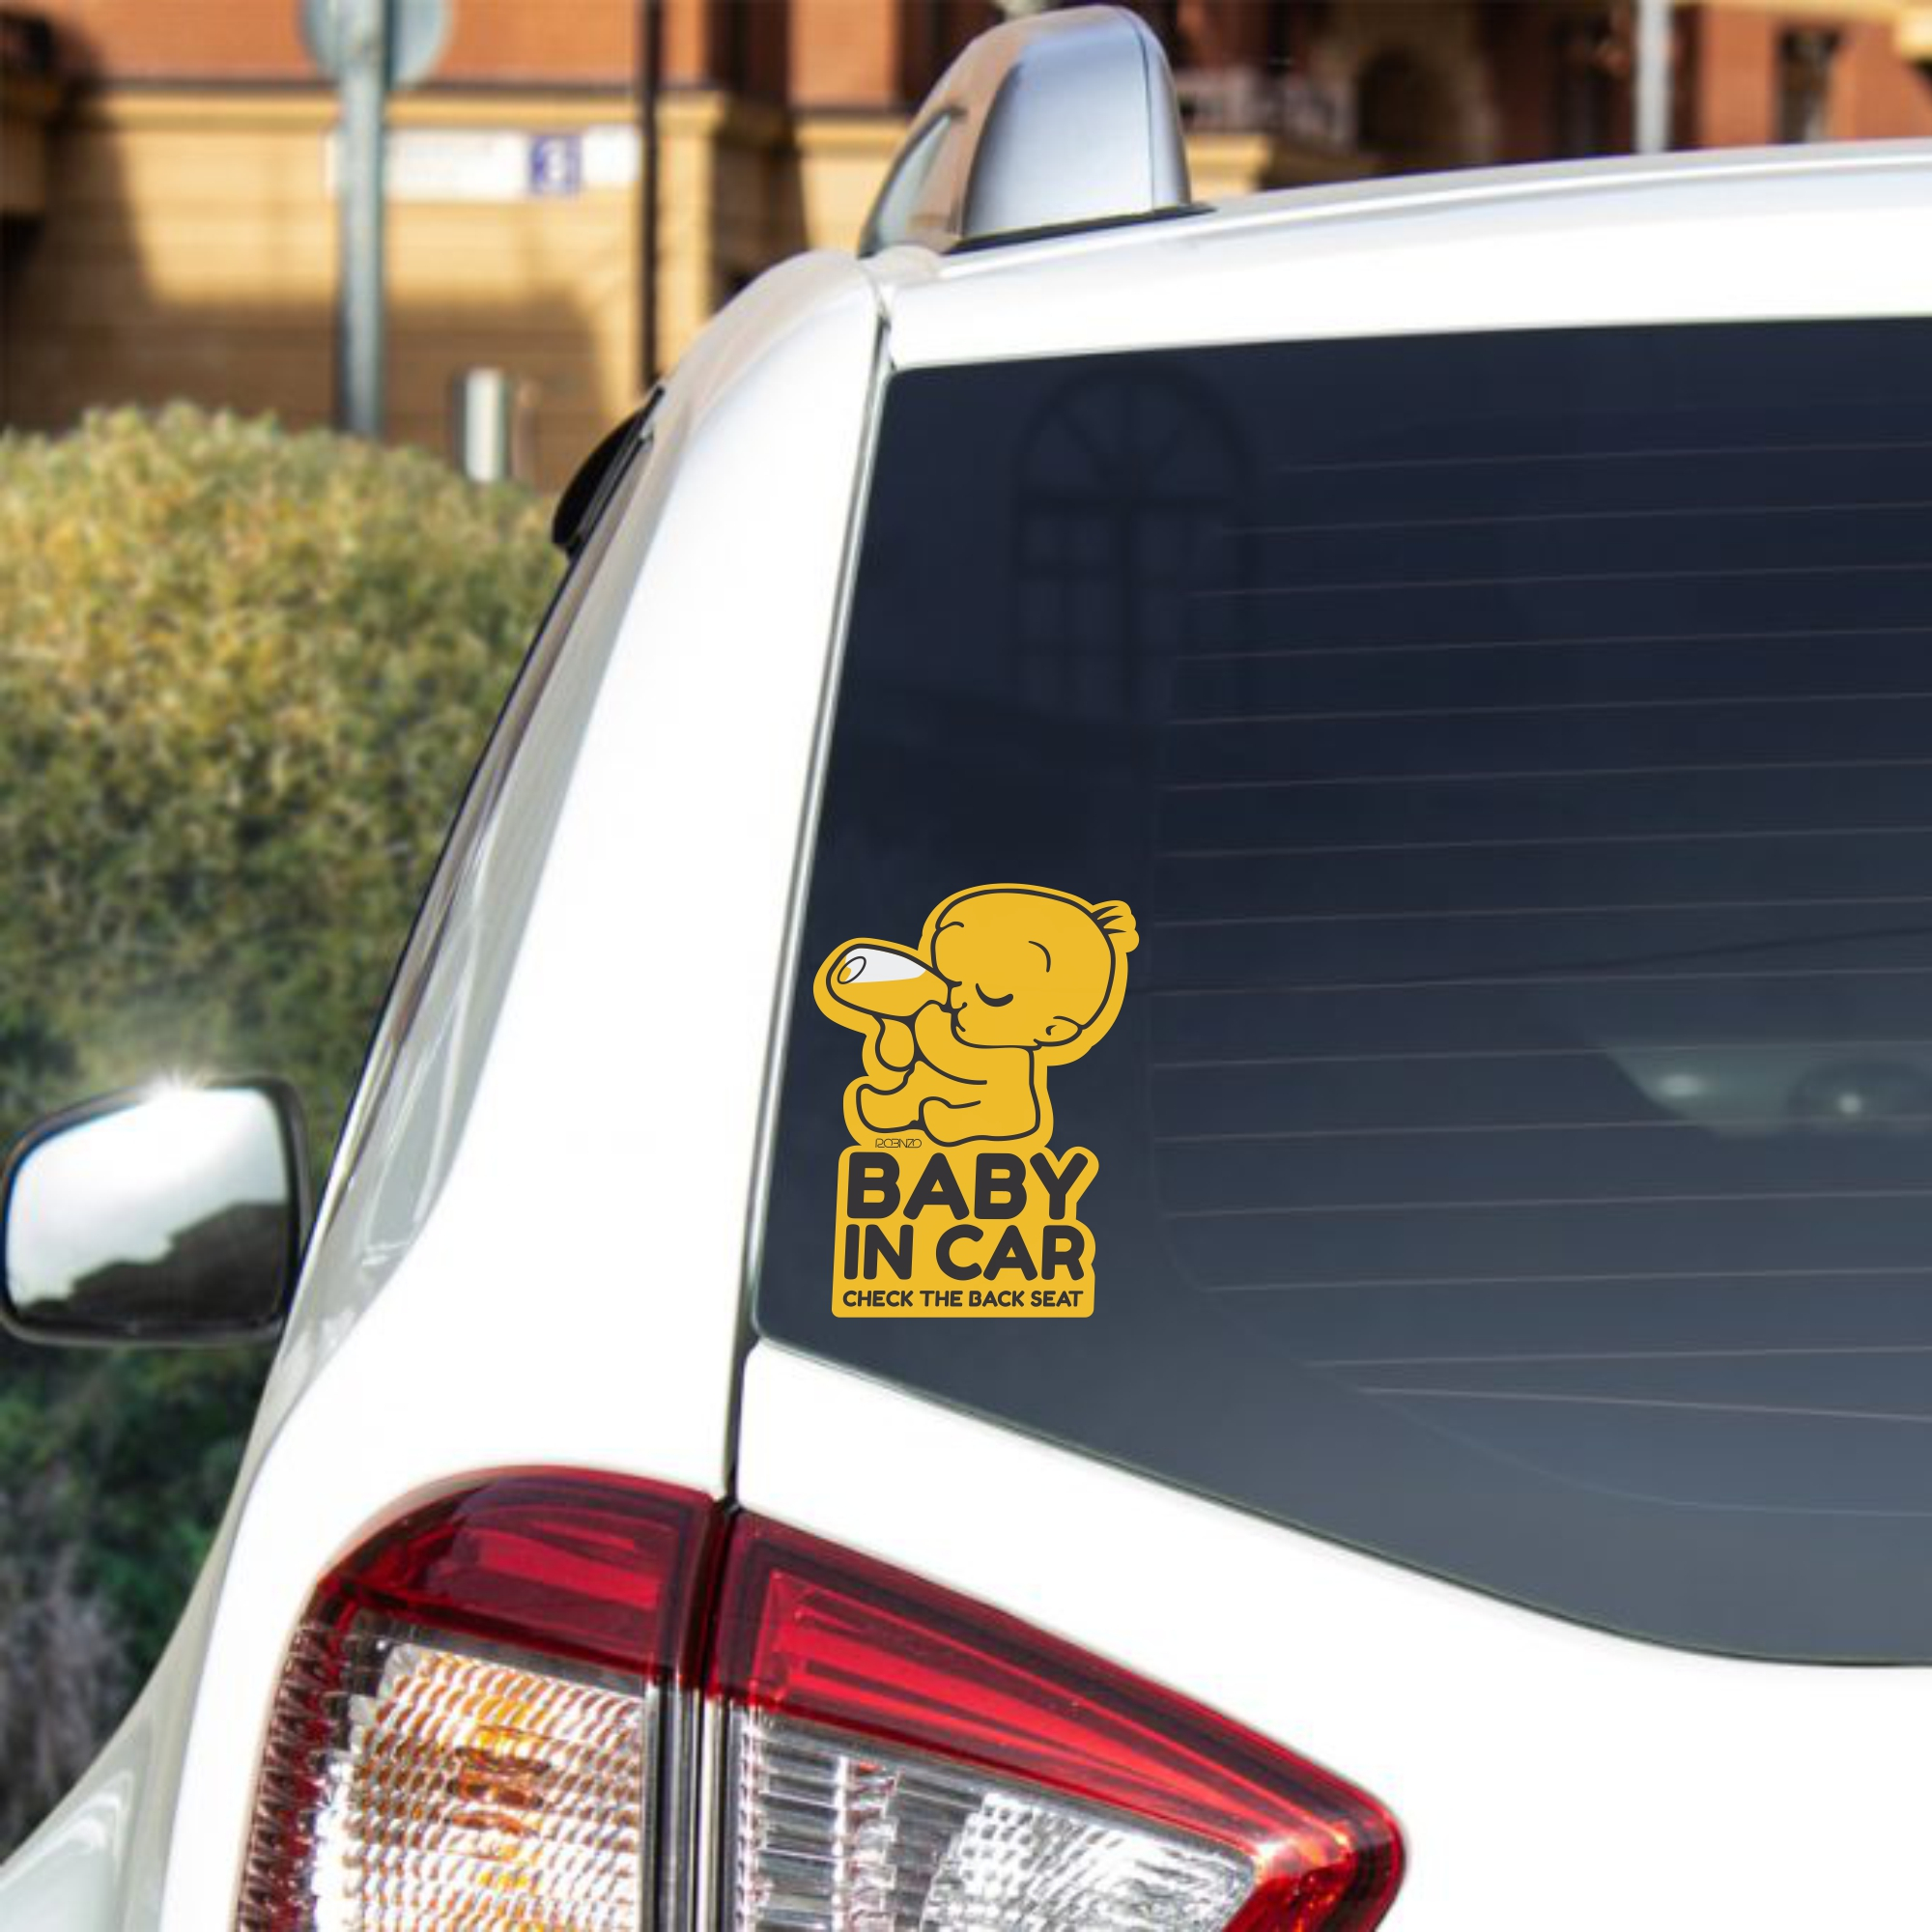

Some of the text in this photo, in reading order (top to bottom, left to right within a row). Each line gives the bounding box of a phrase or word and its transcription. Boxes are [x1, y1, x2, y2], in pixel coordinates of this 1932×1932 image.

[847, 1151, 1089, 1220] BABY
[844, 1224, 1085, 1281] IN CAR
[842, 1290, 1084, 1307] CHECK THE BACK SEAT
